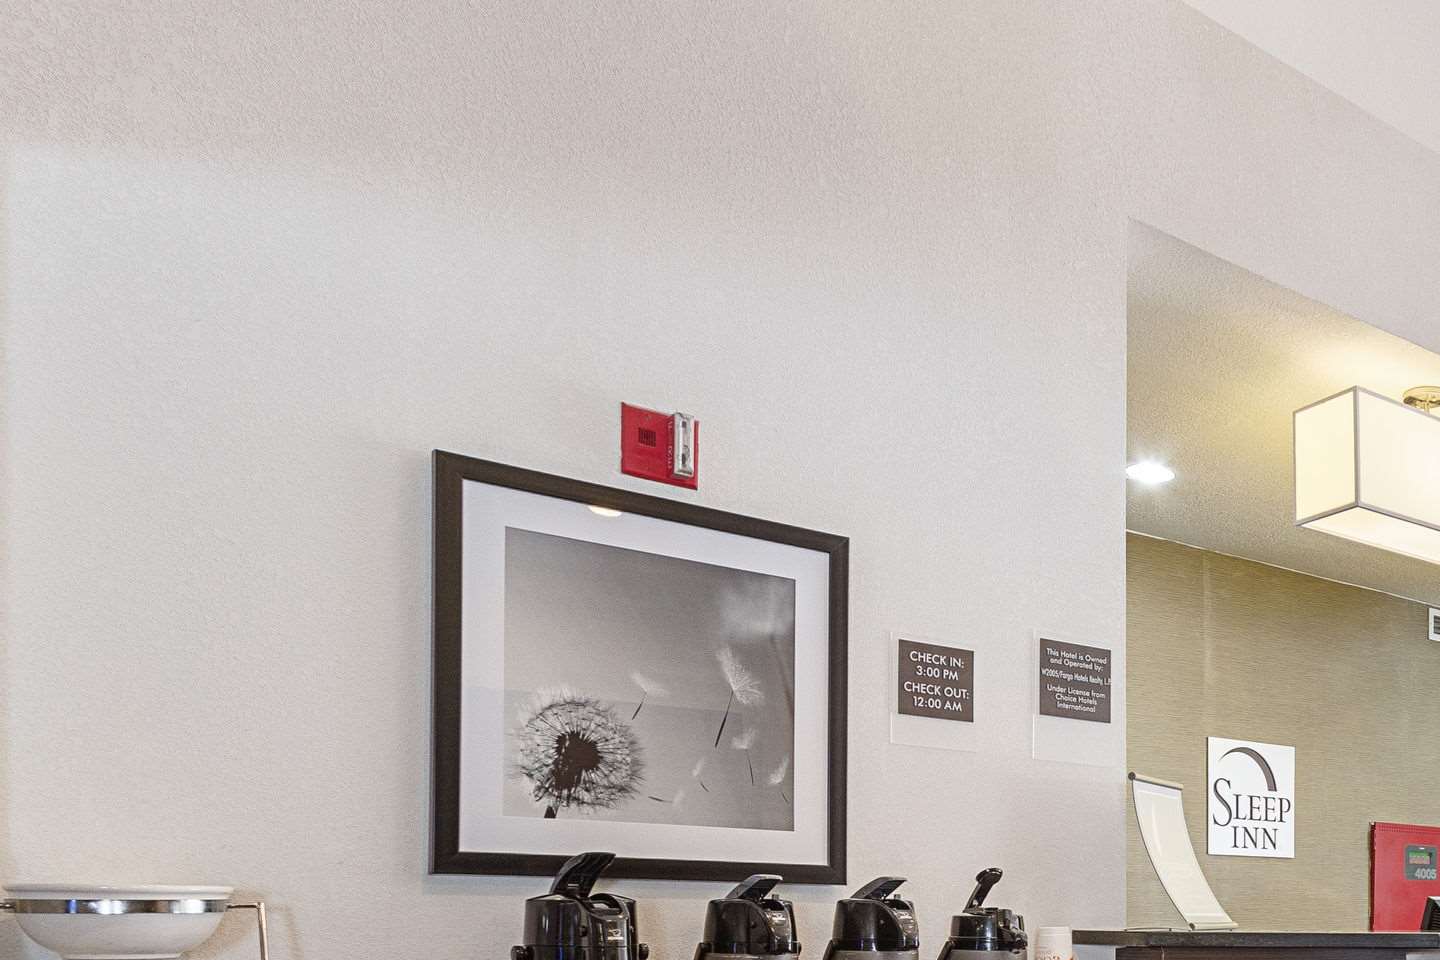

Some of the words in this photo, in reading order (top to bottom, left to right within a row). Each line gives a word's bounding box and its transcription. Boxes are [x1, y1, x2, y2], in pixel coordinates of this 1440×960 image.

[909, 650, 947, 666] CHECK
[950, 656, 965, 669] IN:
[1046, 647, 1059, 657] This
[1060, 650, 1077, 660] Hotel
[1078, 653, 1084, 661] is
[1085, 654, 1107, 665] Owned
[1049, 657, 1062, 665] and
[1063, 658, 1093, 670] Operated
[916, 665, 940, 678] 3:00
[943, 669, 959, 681] PM
[903, 681, 941, 696] CHECK
[944, 686, 970, 700] OUT:
[1046, 683, 1067, 693] Under
[1067, 687, 1090, 697] License
[1091, 689, 1106, 699] from
[913, 695, 941, 709] 12:00
[943, 700, 962, 712] AM
[1055, 693, 1077, 703] Choice
[1078, 696, 1097, 706] Hotels
[1056, 701, 1096, 713] International
[1212, 777, 1291, 827] SLEEP
[1231, 826, 1280, 850] INN
[1415, 868, 1437, 880] 4005
